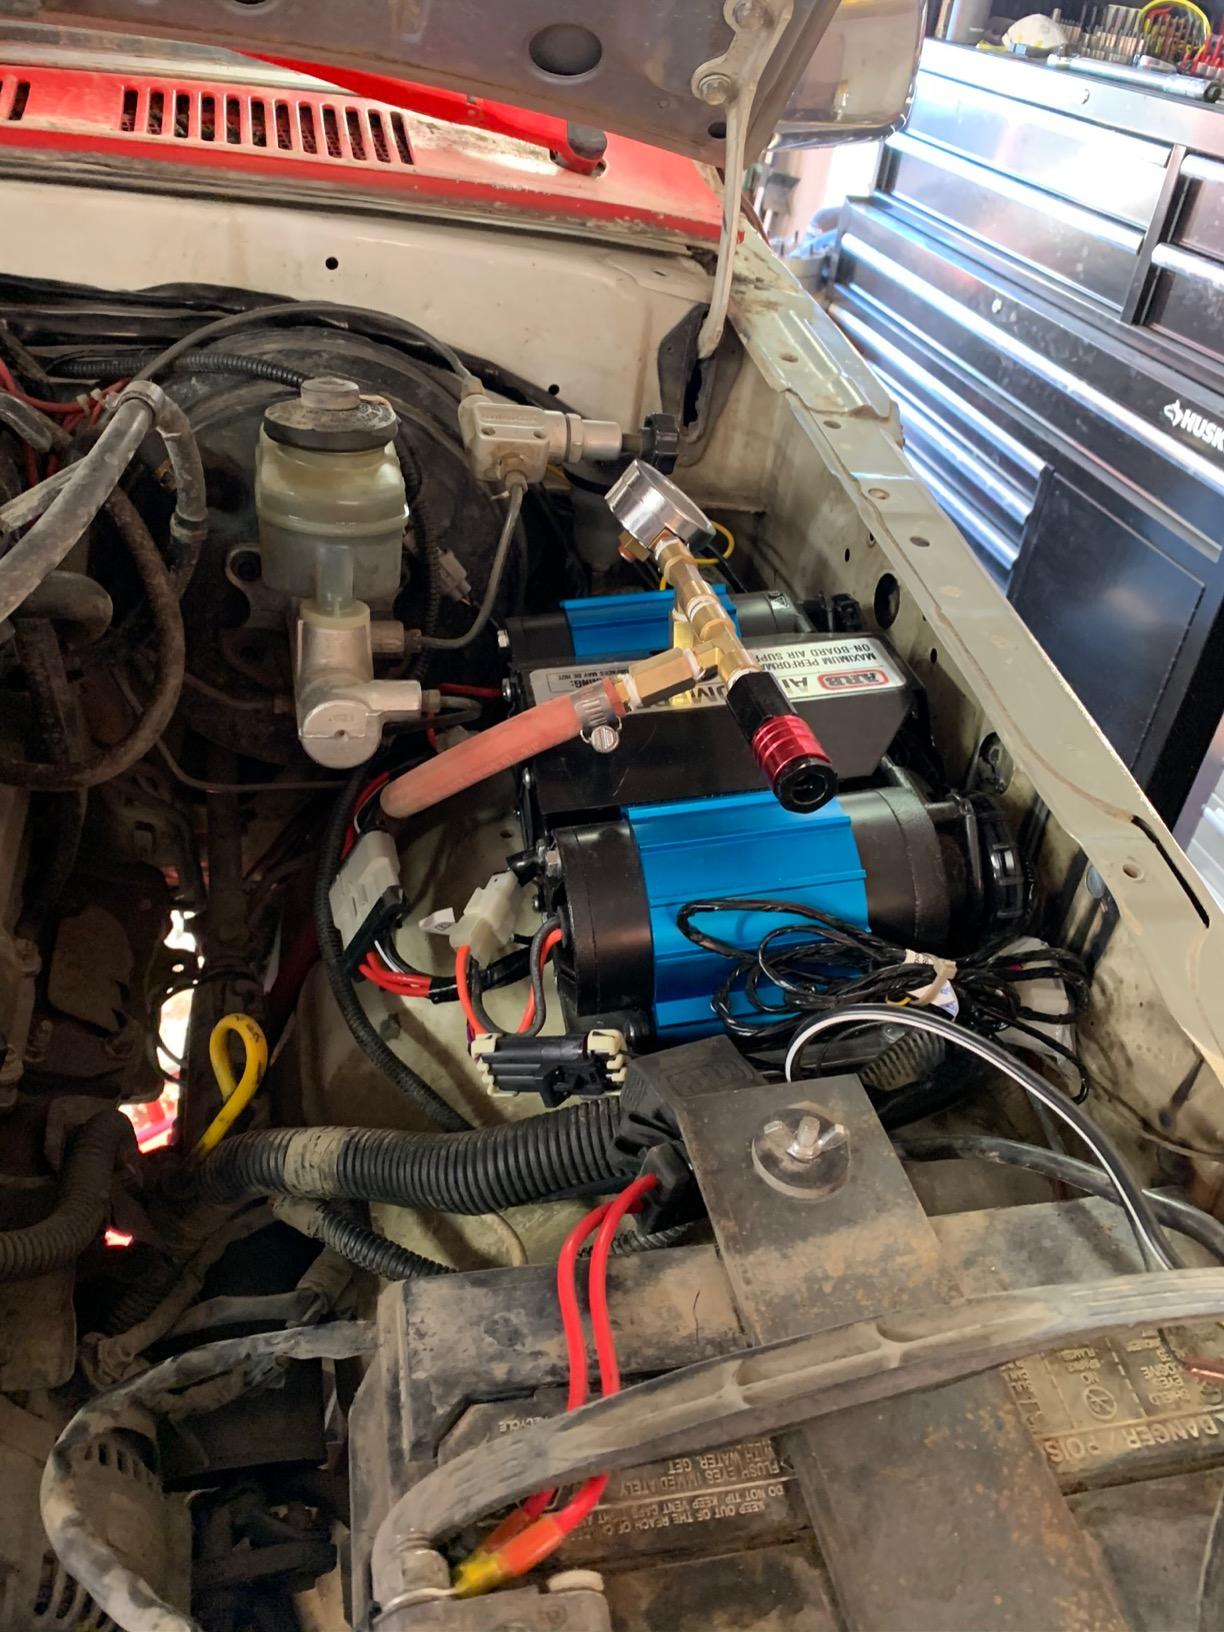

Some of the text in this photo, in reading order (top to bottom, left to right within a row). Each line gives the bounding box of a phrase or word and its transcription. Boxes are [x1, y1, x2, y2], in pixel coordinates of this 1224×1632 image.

[1180, 408, 1224, 452] HUSK
[755, 643, 871, 663] ON-BOARD AIR SUP
[759, 651, 877, 672] MAXIMUM PERFORMA
[781, 676, 809, 695] AI
[824, 671, 879, 689] ARB
[498, 1417, 543, 1432] CYCLE
[1122, 1414, 1217, 1448] DANGER
[744, 1446, 775, 1462] WITH
[1040, 1434, 1102, 1464] POIS
[668, 1457, 692, 1474] GET
[619, 1460, 780, 1497] FLUSH EYES IMMEDATELY
[744, 1489, 765, 1501] NOT
[768, 1484, 784, 1497] DO
[692, 1496, 719, 1509] KEEP
[739, 1501, 765, 1514] KEEP
[672, 1513, 693, 1524] THE
[696, 1509, 711, 1521] OF
[714, 1505, 735, 1518] OUT
[619, 1522, 631, 1534] OF
[635, 1516, 670, 1530] REACH
